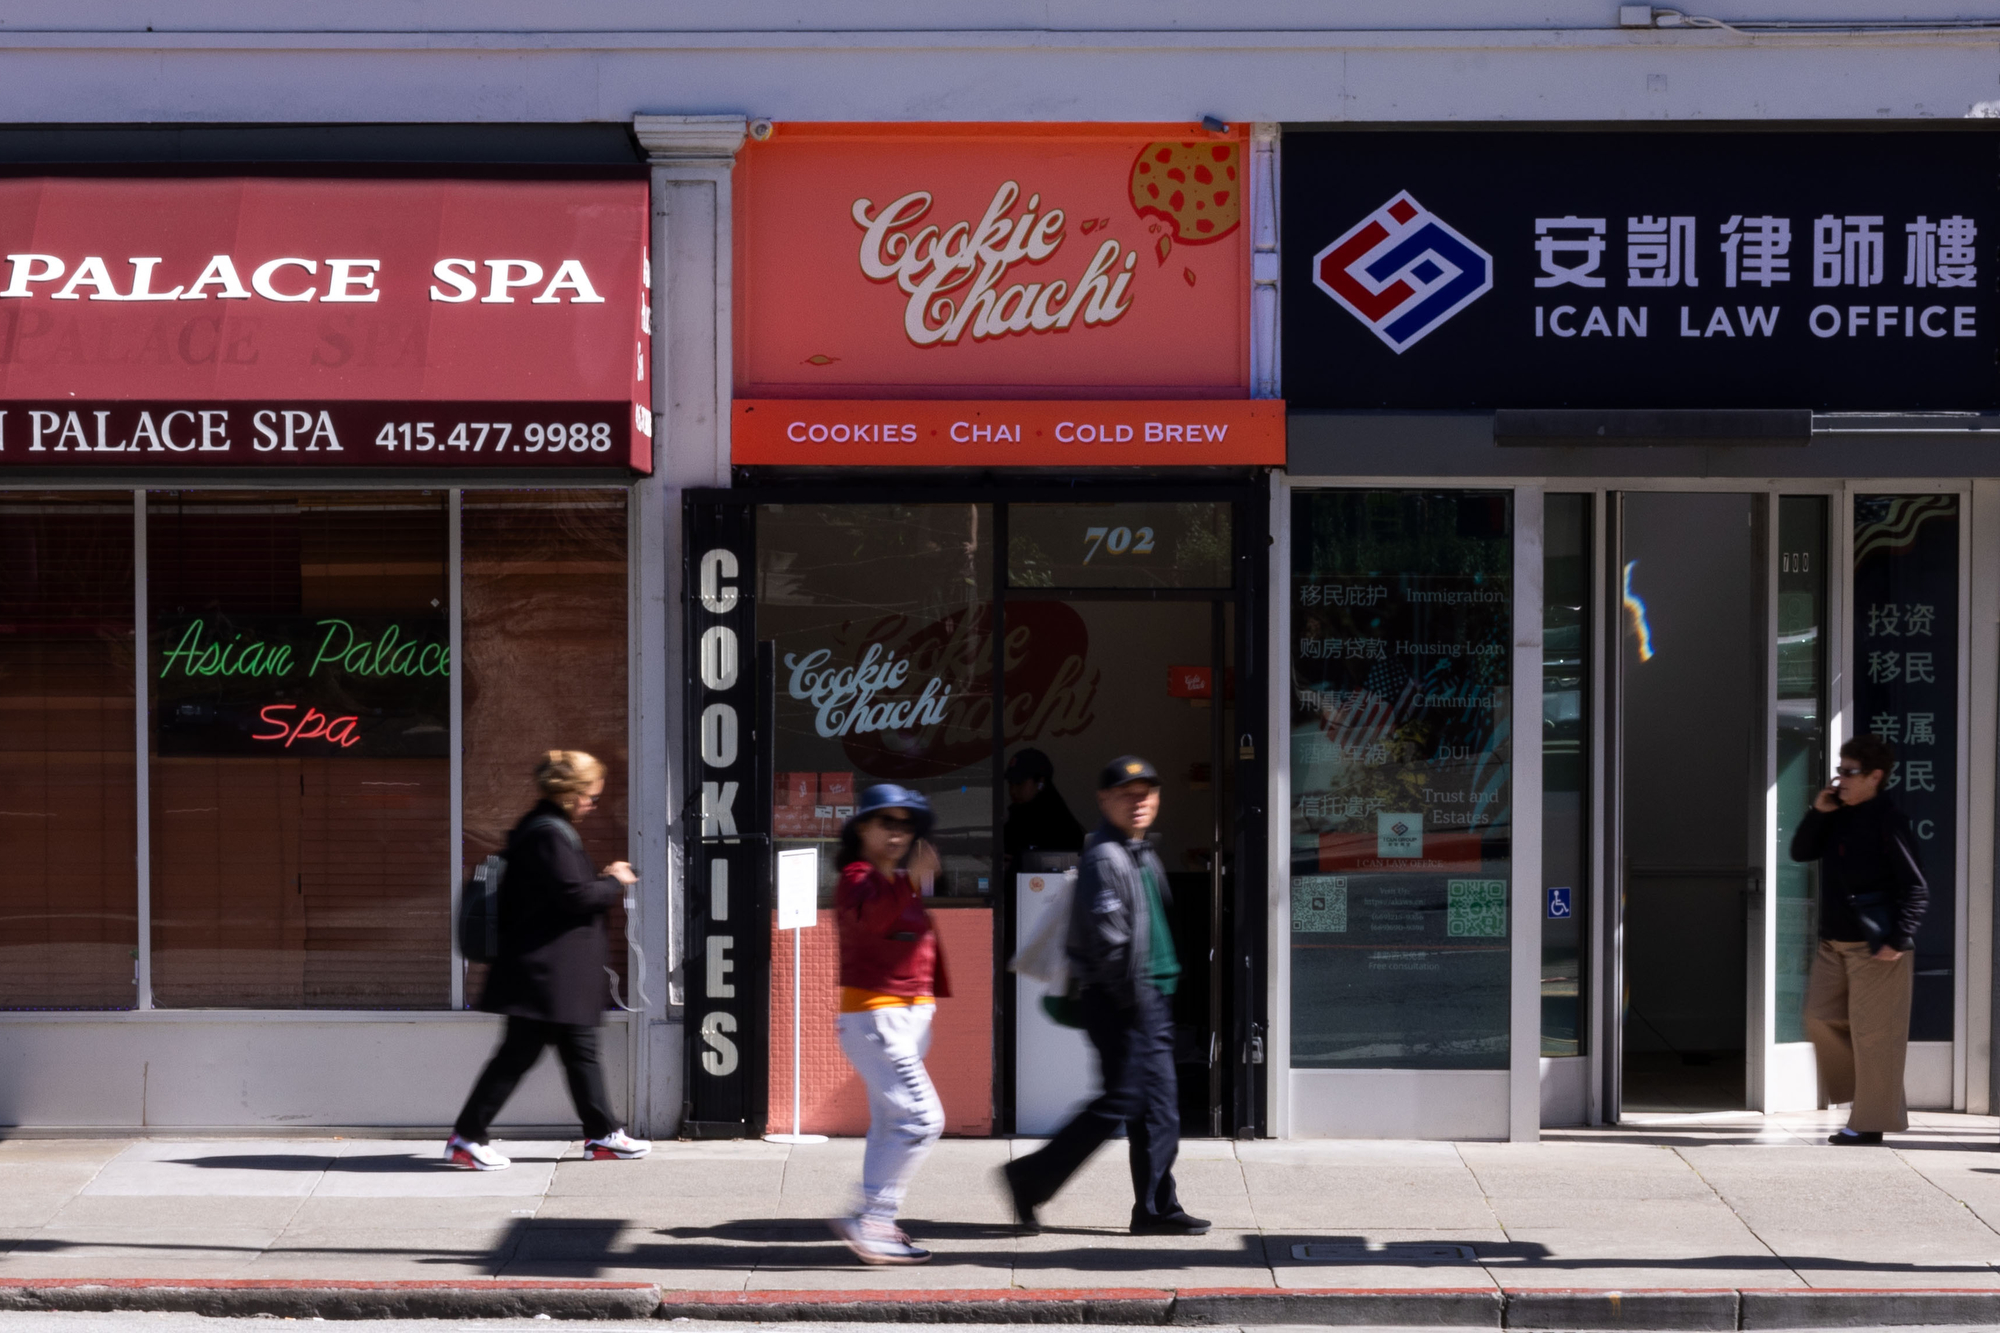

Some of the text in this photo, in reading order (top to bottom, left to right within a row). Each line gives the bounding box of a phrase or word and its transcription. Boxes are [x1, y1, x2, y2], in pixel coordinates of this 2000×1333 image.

[850, 180, 1067, 282] Cookie
[1534, 214, 1978, 289] 安凱律師樓
[0, 254, 381, 303] PALACE
[429, 258, 606, 304] SPA
[897, 238, 1138, 349] Chachi
[1534, 304, 1978, 338] ICAN LAW OFFICE
[28, 410, 231, 452] PALACE
[252, 410, 344, 452] SPA
[374, 422, 612, 453] 415.477.9988
[1083, 525, 1156, 566] 702
[1782, 552, 1810, 573] 700
[1299, 584, 1388, 606] 移民庇护
[1406, 587, 1505, 605] Immigration
[1867, 603, 1936, 638] 投资
[159, 619, 295, 678] Asian
[1299, 637, 1388, 660] 购房贷款
[1395, 640, 1506, 658] Housing Loan
[784, 642, 909, 702] Cookie
[1867, 650, 1936, 685] 移民
[811, 676, 952, 738] Chachi
[252, 704, 361, 748] Spa
[1869, 711, 1936, 746] 亲属
[1438, 745, 1471, 760] DUI
[701, 548, 739, 1077] COOKIES
[1298, 795, 1387, 818] 信托遗产
[1422, 788, 1500, 804] Trust and
[1432, 810, 1490, 825] Estates
[1368, 962, 1440, 971] Free consultation
